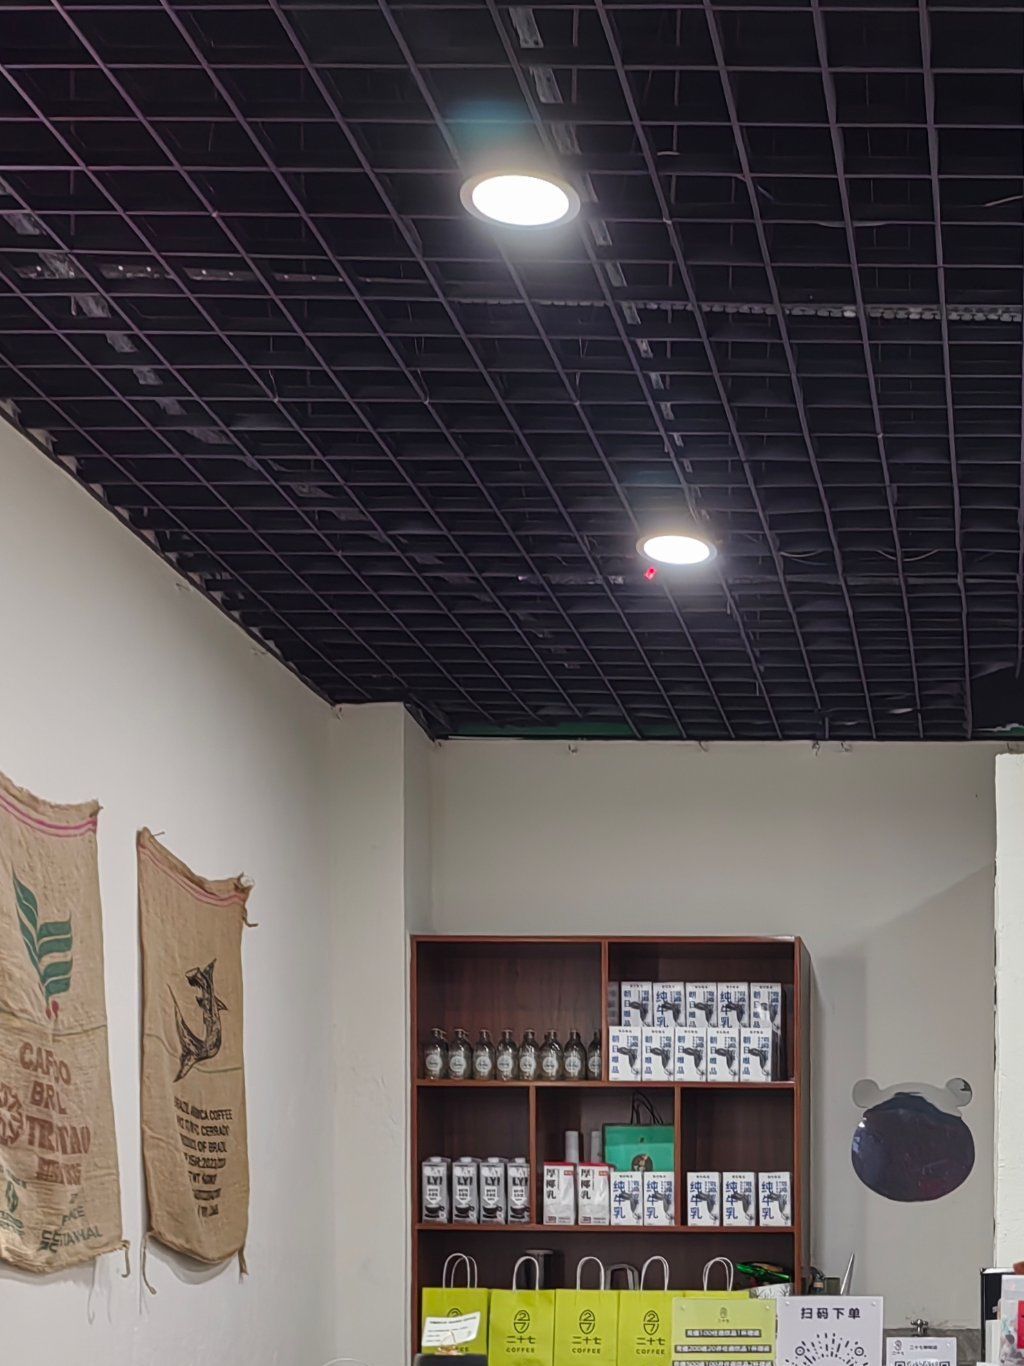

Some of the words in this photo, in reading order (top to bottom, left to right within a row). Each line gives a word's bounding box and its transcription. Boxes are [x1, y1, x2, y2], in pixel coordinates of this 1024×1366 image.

[613, 1180, 626, 1219] 纯牛乳
[646, 1180, 658, 1219] 纯牛乳
[690, 1181, 703, 1219] 纯牛乳
[725, 1181, 738, 1219] 纯牛乳
[761, 1181, 774, 1220] 纯牛乳
[800, 1307, 861, 1320] 扫码下单
[506, 1335, 536, 1344] 二十七
[572, 1336, 602, 1345] 二十七
[636, 1337, 666, 1346] 二十七
